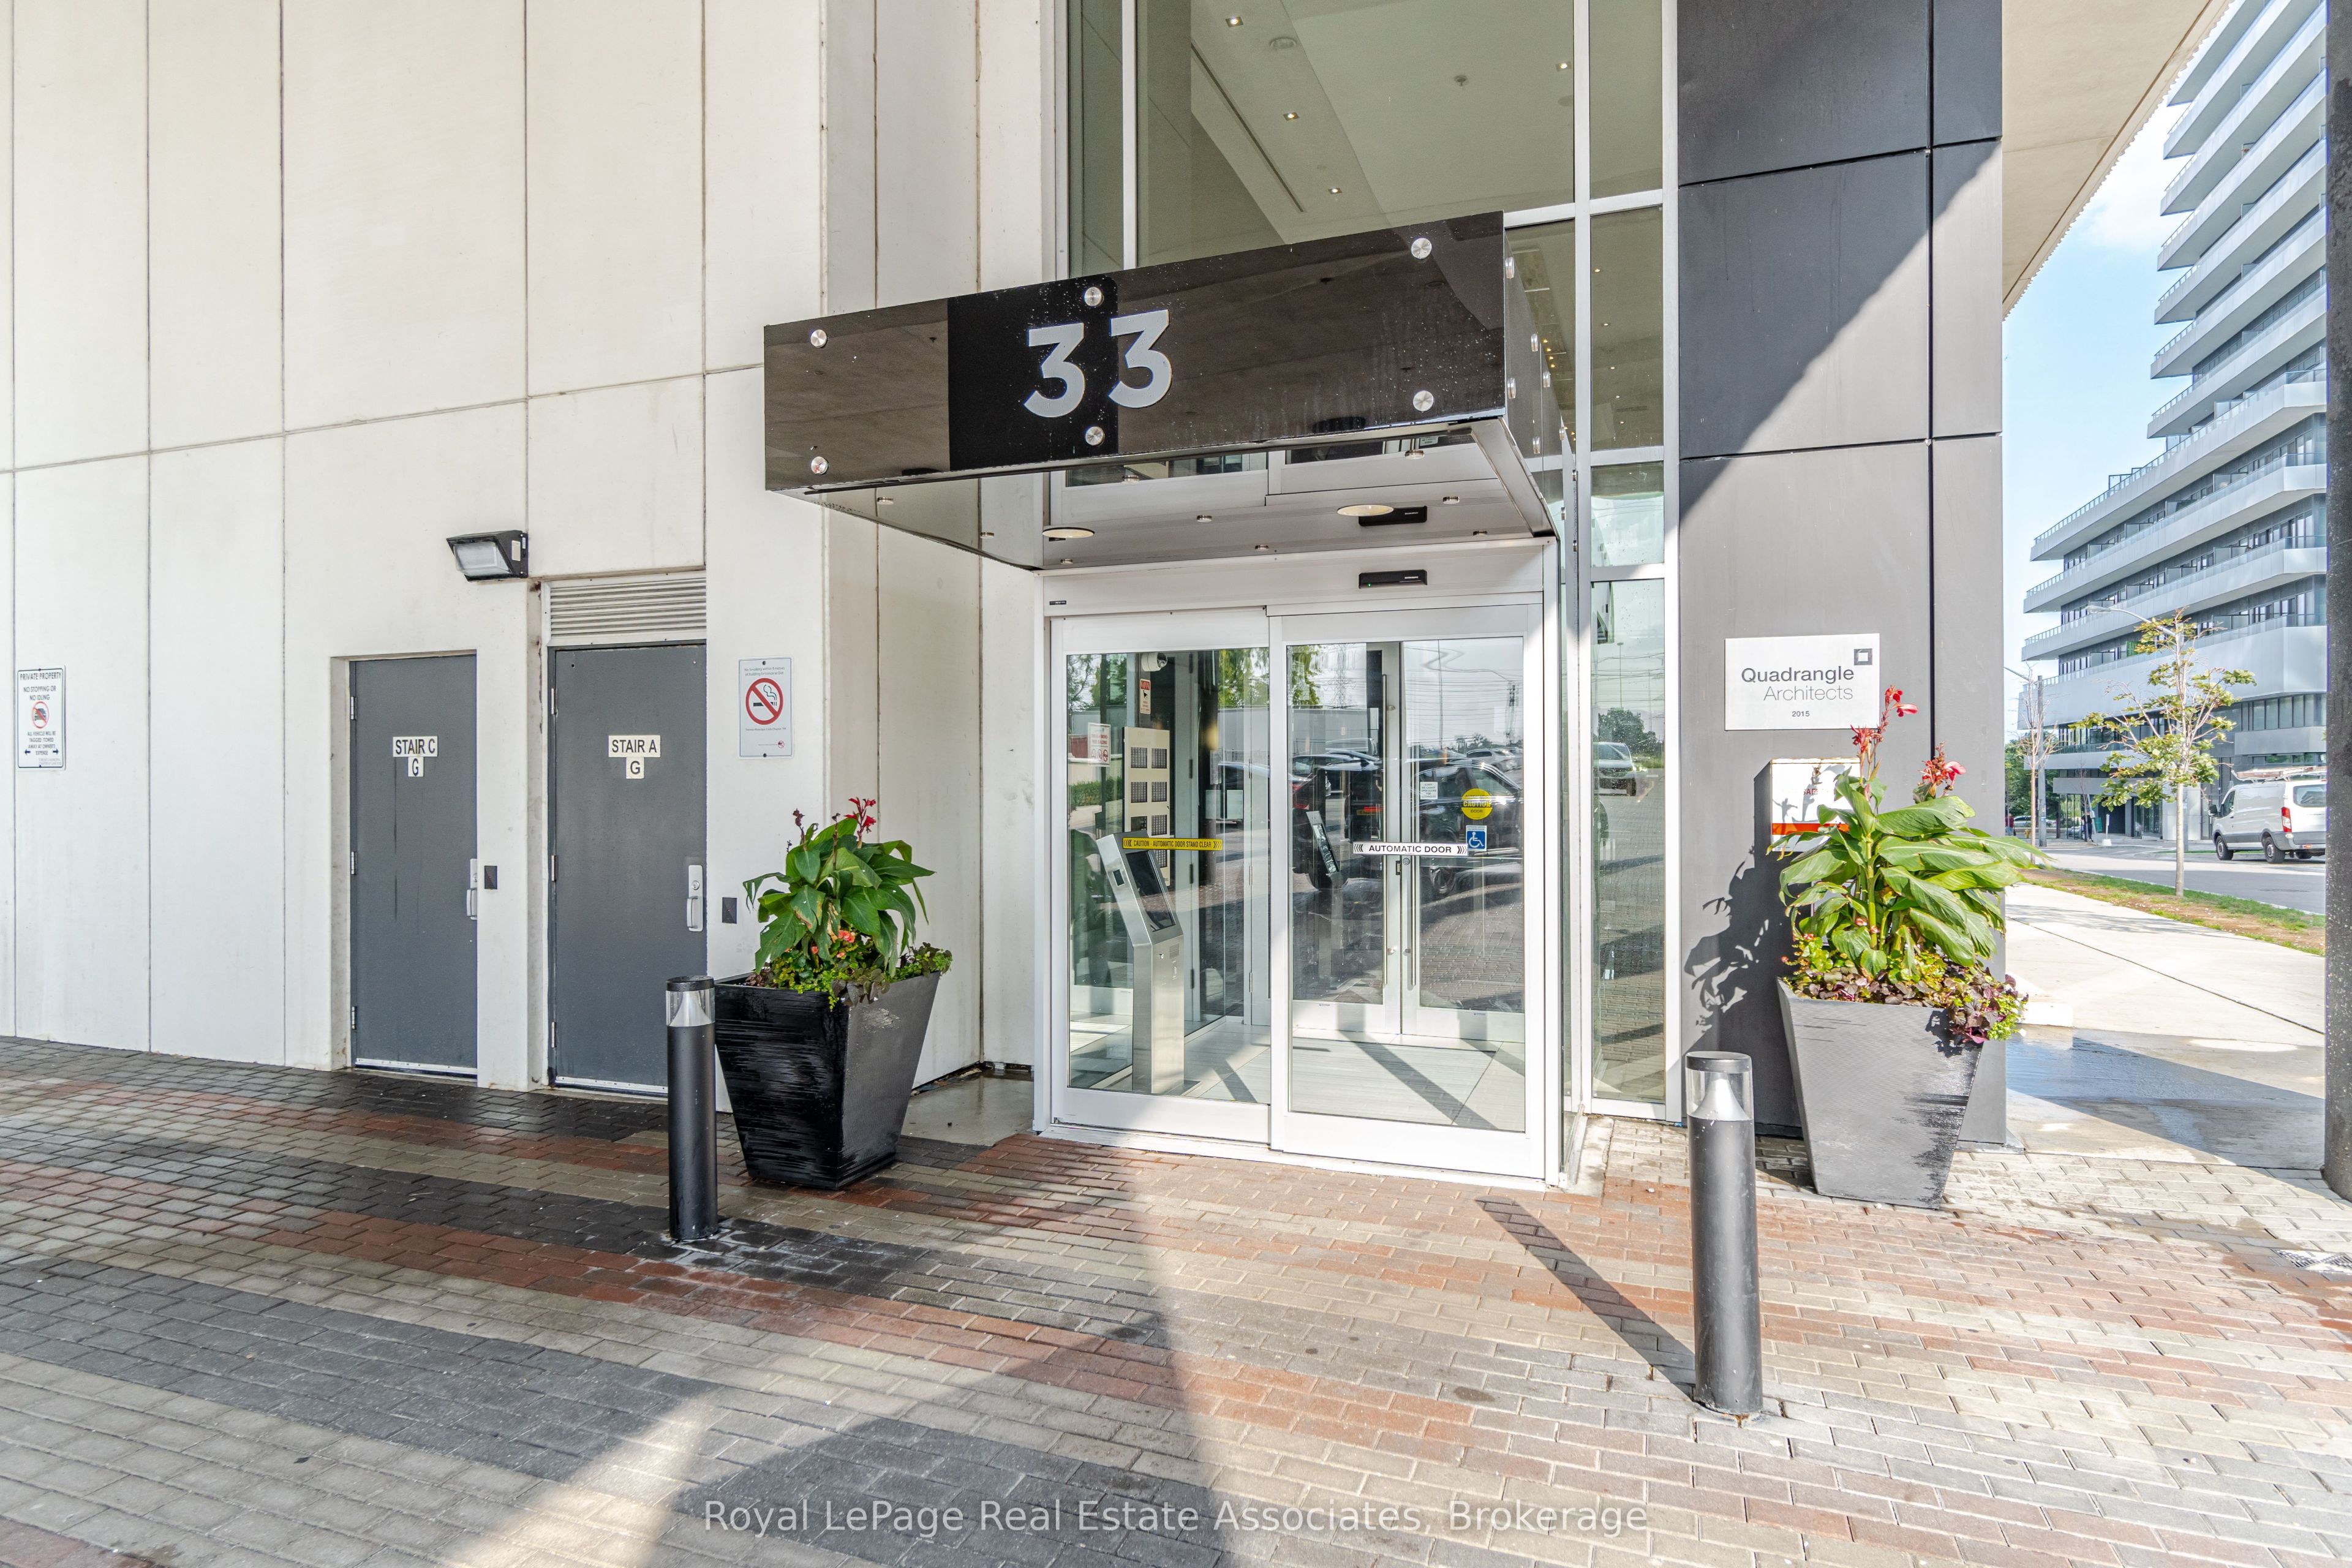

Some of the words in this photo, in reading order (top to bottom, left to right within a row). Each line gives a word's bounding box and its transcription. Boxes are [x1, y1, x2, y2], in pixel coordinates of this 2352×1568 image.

[1741, 666, 1854, 684] Quadrangle
[1763, 685, 1853, 701] Architects
[396, 739, 425, 755] STAIR
[429, 738, 435, 754] C
[612, 739, 645, 753] STAIR
[649, 739, 657, 753] A
[412, 758, 419, 776] G
[630, 761, 641, 774] G
